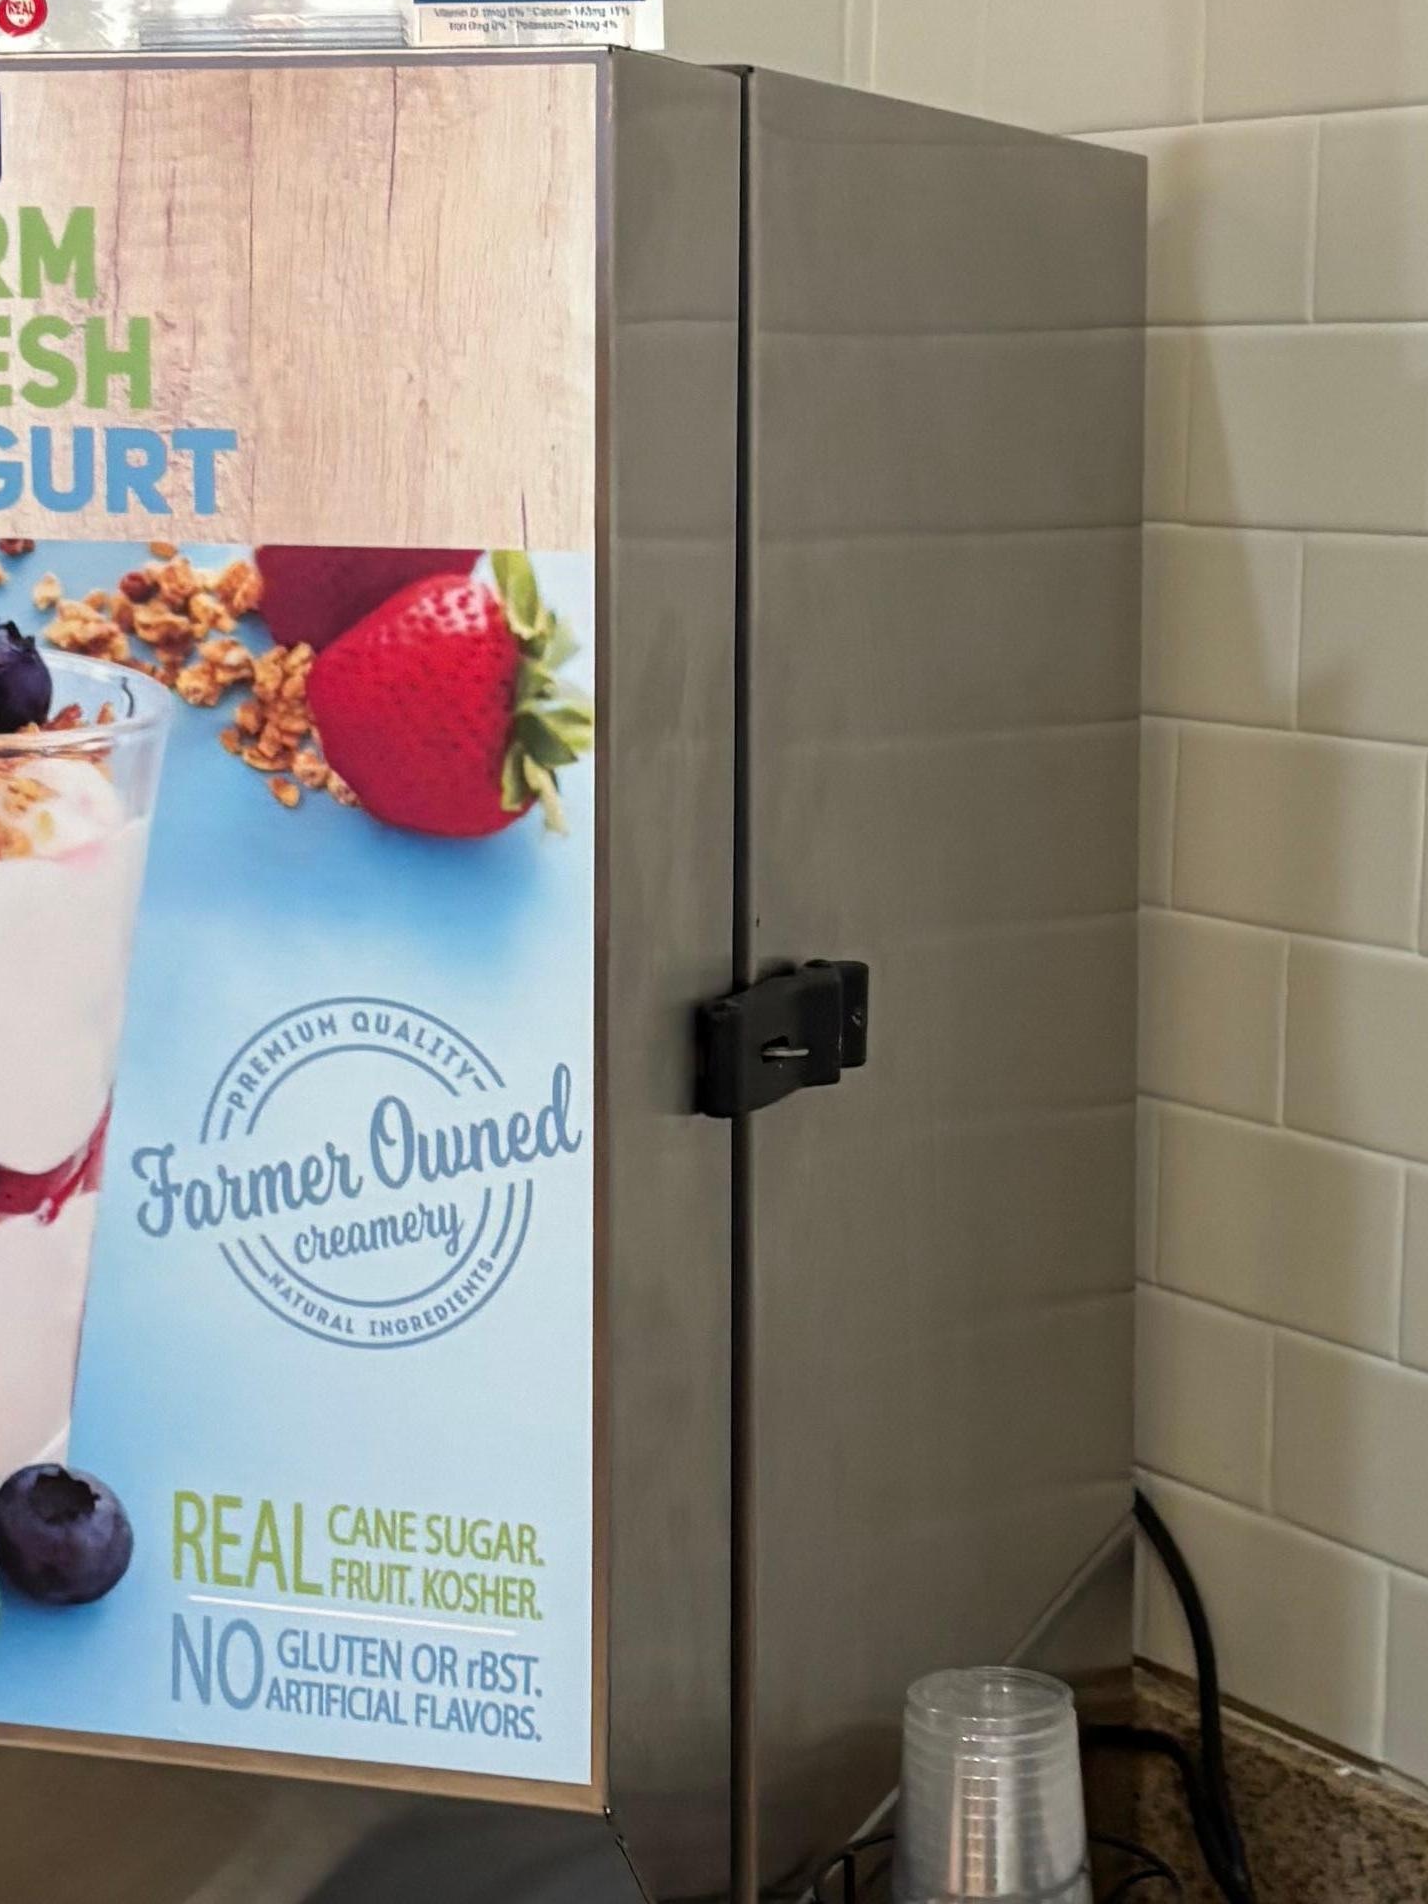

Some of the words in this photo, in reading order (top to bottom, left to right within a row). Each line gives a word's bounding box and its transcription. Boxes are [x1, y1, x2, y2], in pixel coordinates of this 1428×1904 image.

[229, 1012, 338, 1110] PREMIUM
[352, 1010, 474, 1081] QUALITY
[132, 1142, 363, 1238] Farmer
[370, 1062, 582, 1189] Owned
[294, 1202, 465, 1265] creamery
[268, 1273, 355, 1335] NATURAL
[369, 1258, 494, 1338] INGREDIENTS
[173, 1490, 323, 1596] REAL
[328, 1504, 417, 1552] CANE
[425, 1514, 545, 1566] SUGAR.
[330, 1558, 414, 1606] FRUIT.
[423, 1568, 543, 1620] KOSHER.
[172, 1612, 264, 1710] NO
[277, 1628, 402, 1681] GLUTEN
[412, 1643, 457, 1687] OR
[467, 1650, 543, 1697] rBST.
[265, 1677, 407, 1726] ARTIFICIAL
[415, 1693, 542, 1743] FLAVORS.
